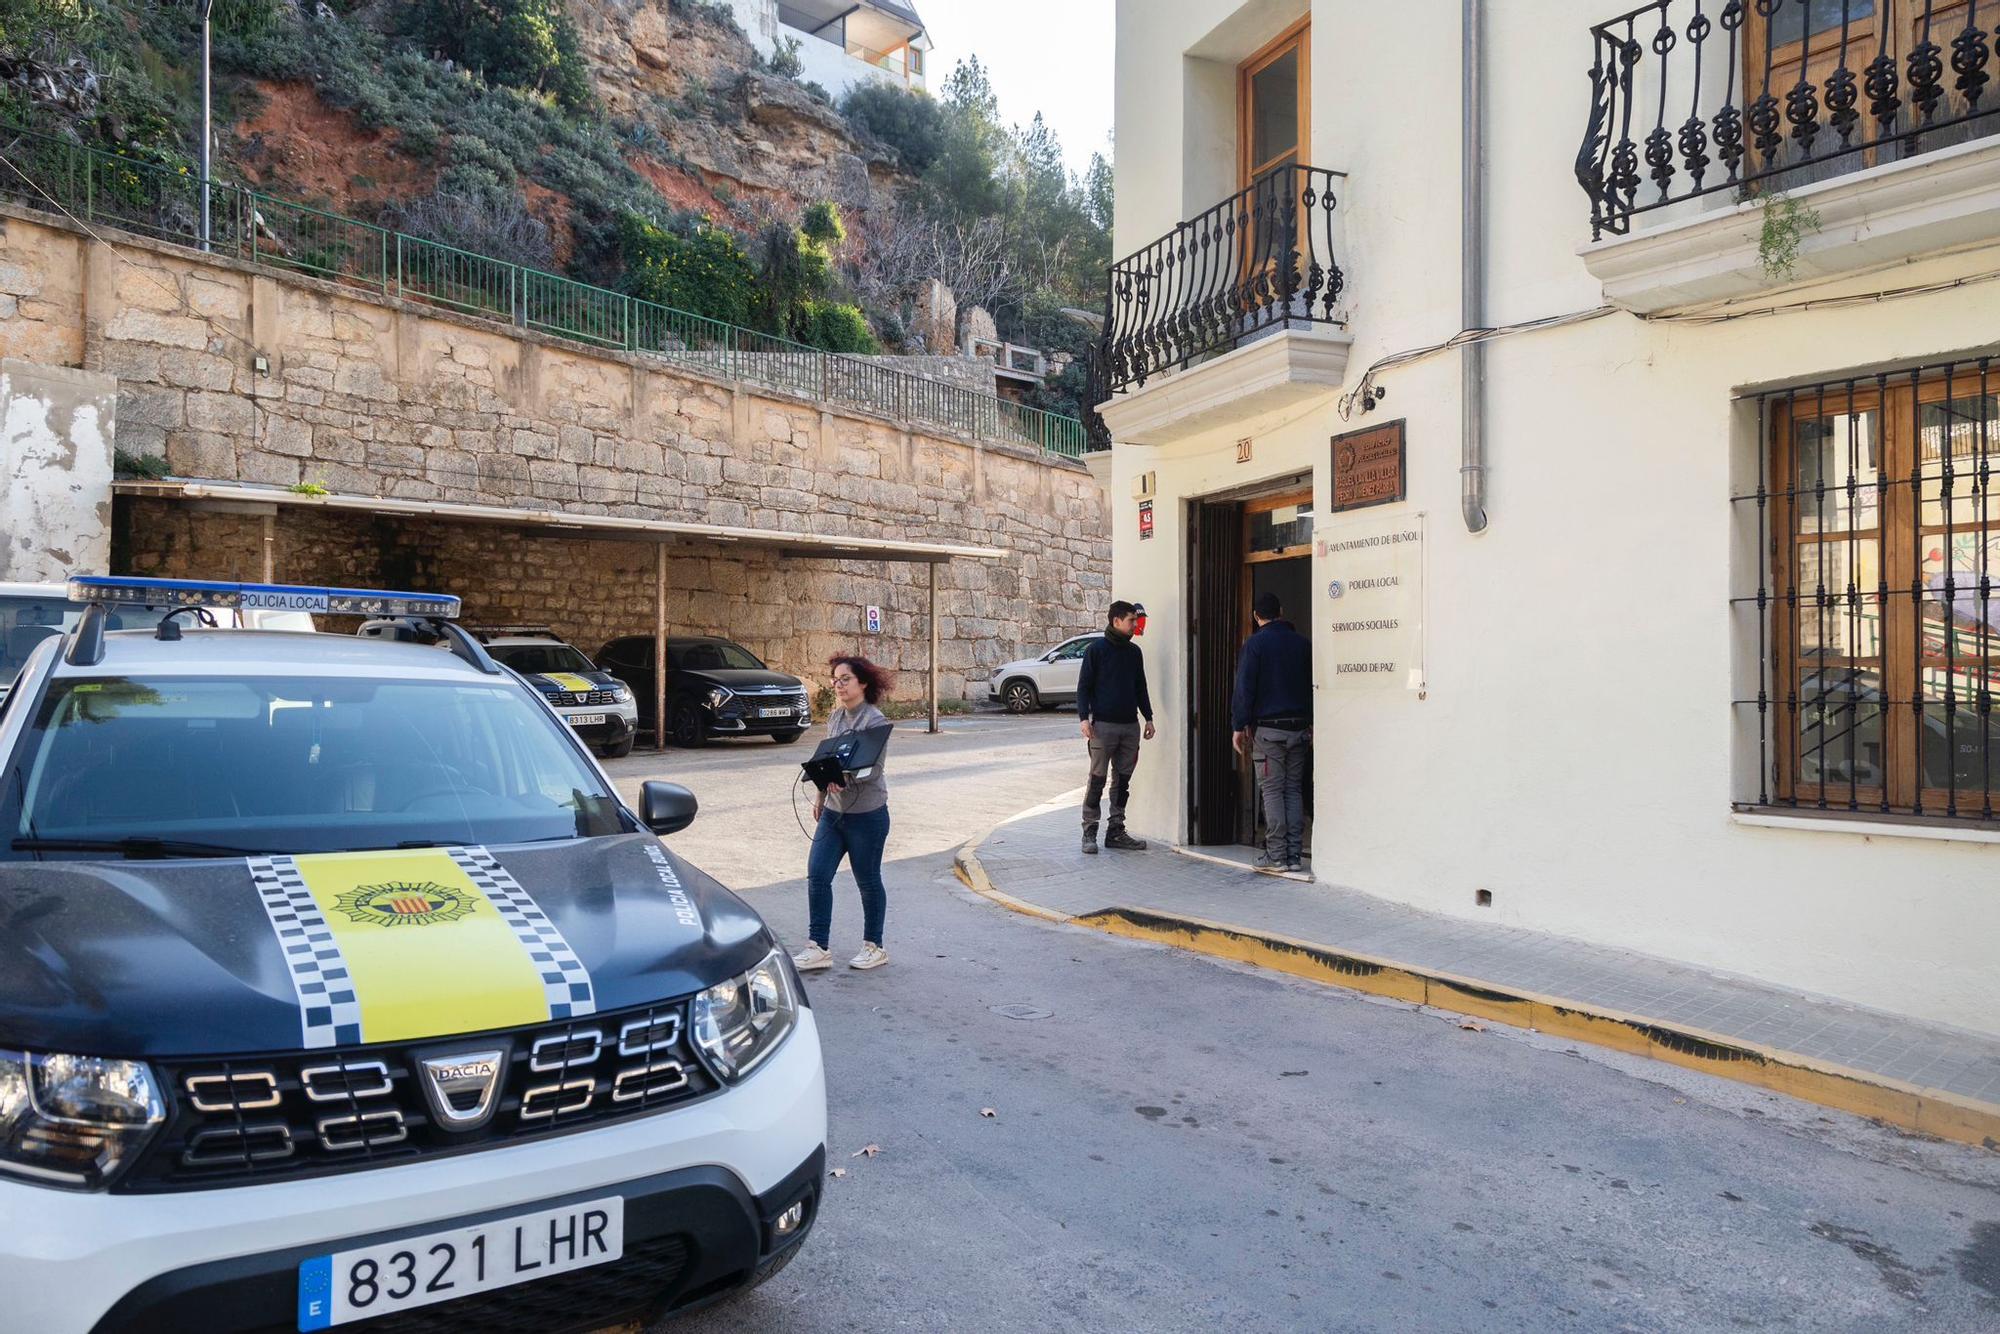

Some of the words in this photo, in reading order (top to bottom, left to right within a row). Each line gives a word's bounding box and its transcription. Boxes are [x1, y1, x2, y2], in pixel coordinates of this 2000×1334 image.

[1237, 440, 1250, 459] 20
[1329, 536, 1380, 552] AYUNTAMIENTO
[1381, 535, 1390, 545] DE
[1392, 530, 1418, 544] BUÑOL
[1348, 579, 1375, 590] POLICIA
[1377, 576, 1399, 587] LOCAL
[240, 594, 287, 607] POLICIA
[289, 597, 326, 610] LOCAL
[1332, 620, 1365, 632] SERVICIOS
[1365, 619, 1399, 630] SOCIALES
[1336, 663, 1368, 675] JUZGADO
[1369, 663, 1378, 672] DE
[1380, 662, 1394, 672] PAZ
[569, 716, 588, 725] 8313
[589, 715, 604, 723] LHR
[655, 865, 681, 888] LOCAL
[667, 889, 699, 926] POLICIA
[438, 1062, 492, 1081] DACIA
[348, 1234, 486, 1309] 8321
[514, 1209, 609, 1274] LHR
[309, 1300, 322, 1317] E
